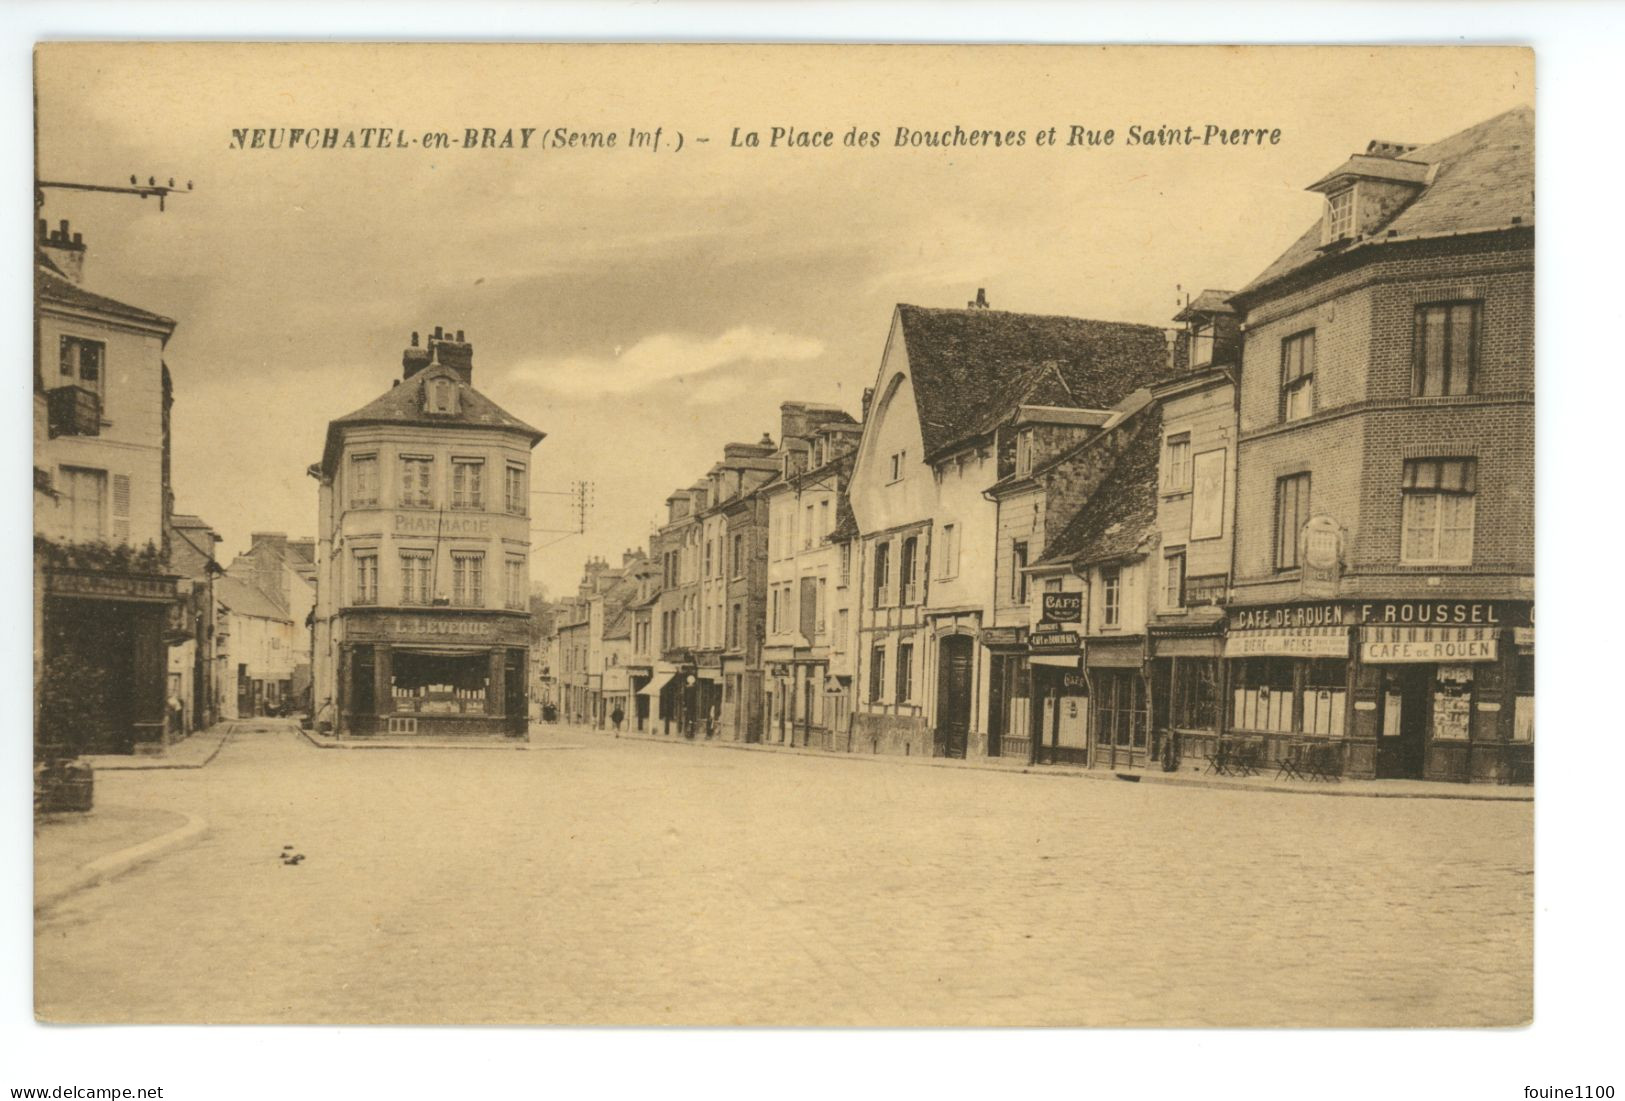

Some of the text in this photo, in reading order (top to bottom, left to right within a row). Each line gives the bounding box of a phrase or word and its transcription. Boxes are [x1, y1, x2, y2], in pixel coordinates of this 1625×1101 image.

[395, 514, 490, 533] PHARMACIE
[1276, 608, 1292, 626] DE
[1297, 605, 1342, 625] ROUEN
[1361, 604, 1499, 622] F. ROUSSEL
[1434, 642, 1490, 657] ROUEN
